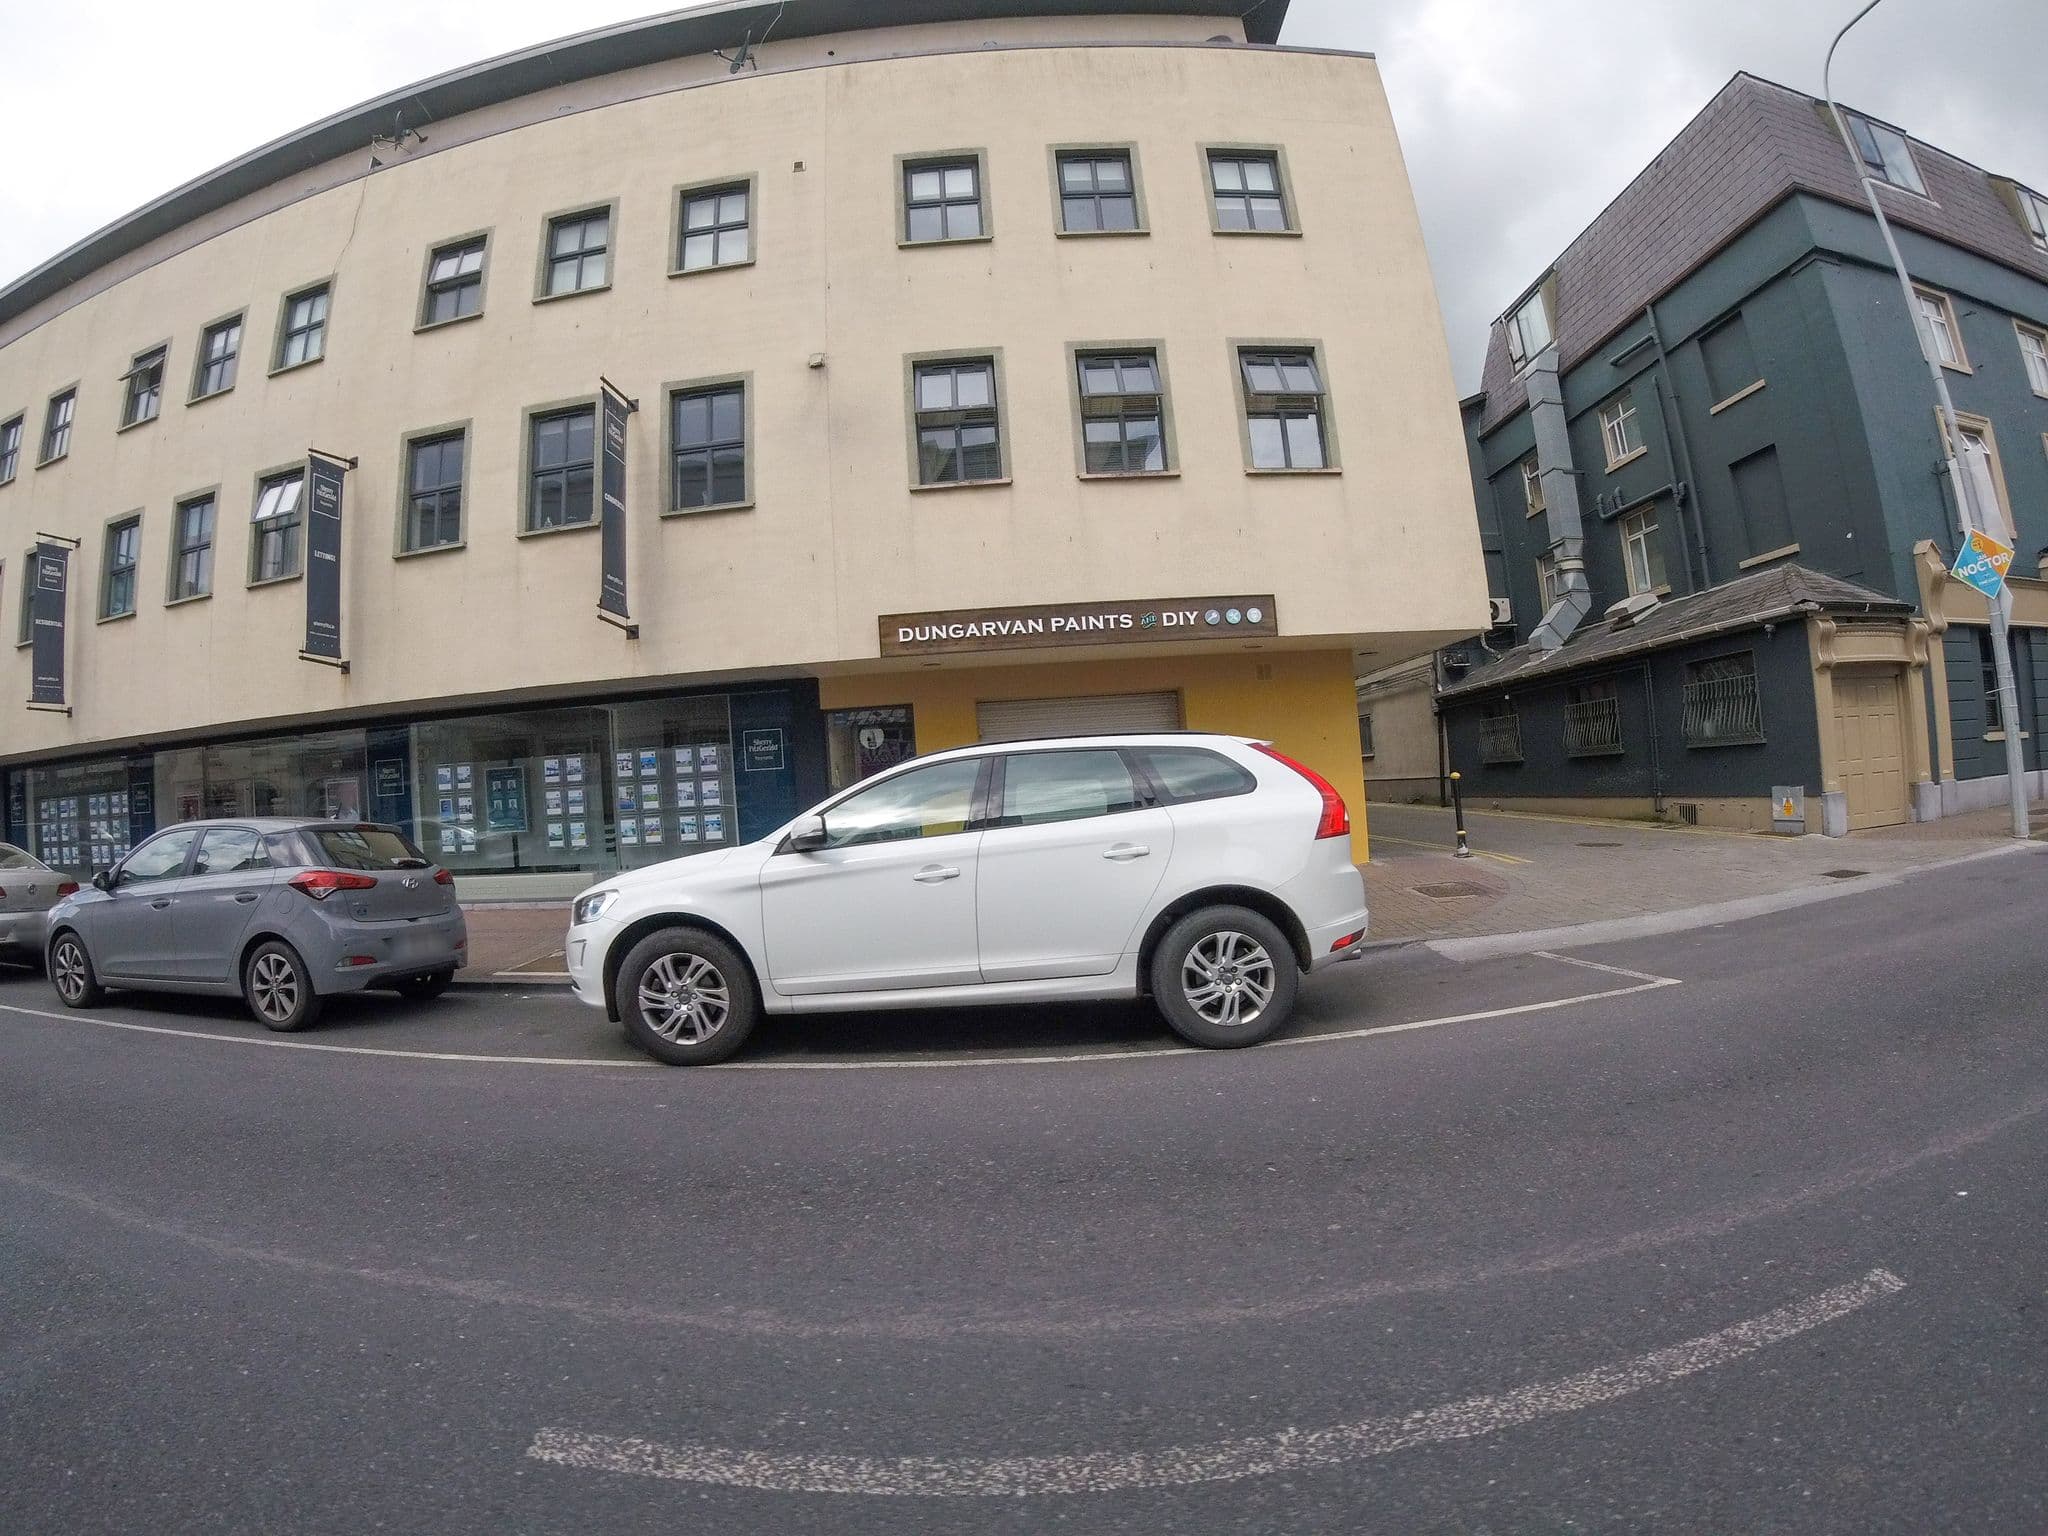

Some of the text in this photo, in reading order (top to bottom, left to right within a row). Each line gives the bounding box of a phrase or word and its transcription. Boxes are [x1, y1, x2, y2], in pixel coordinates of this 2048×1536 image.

[1958, 553, 2009, 577] NOCTOR
[898, 618, 1044, 642] DUNGARVAN
[1050, 613, 1133, 632] PAINTS
[1161, 610, 1199, 627] DIY
